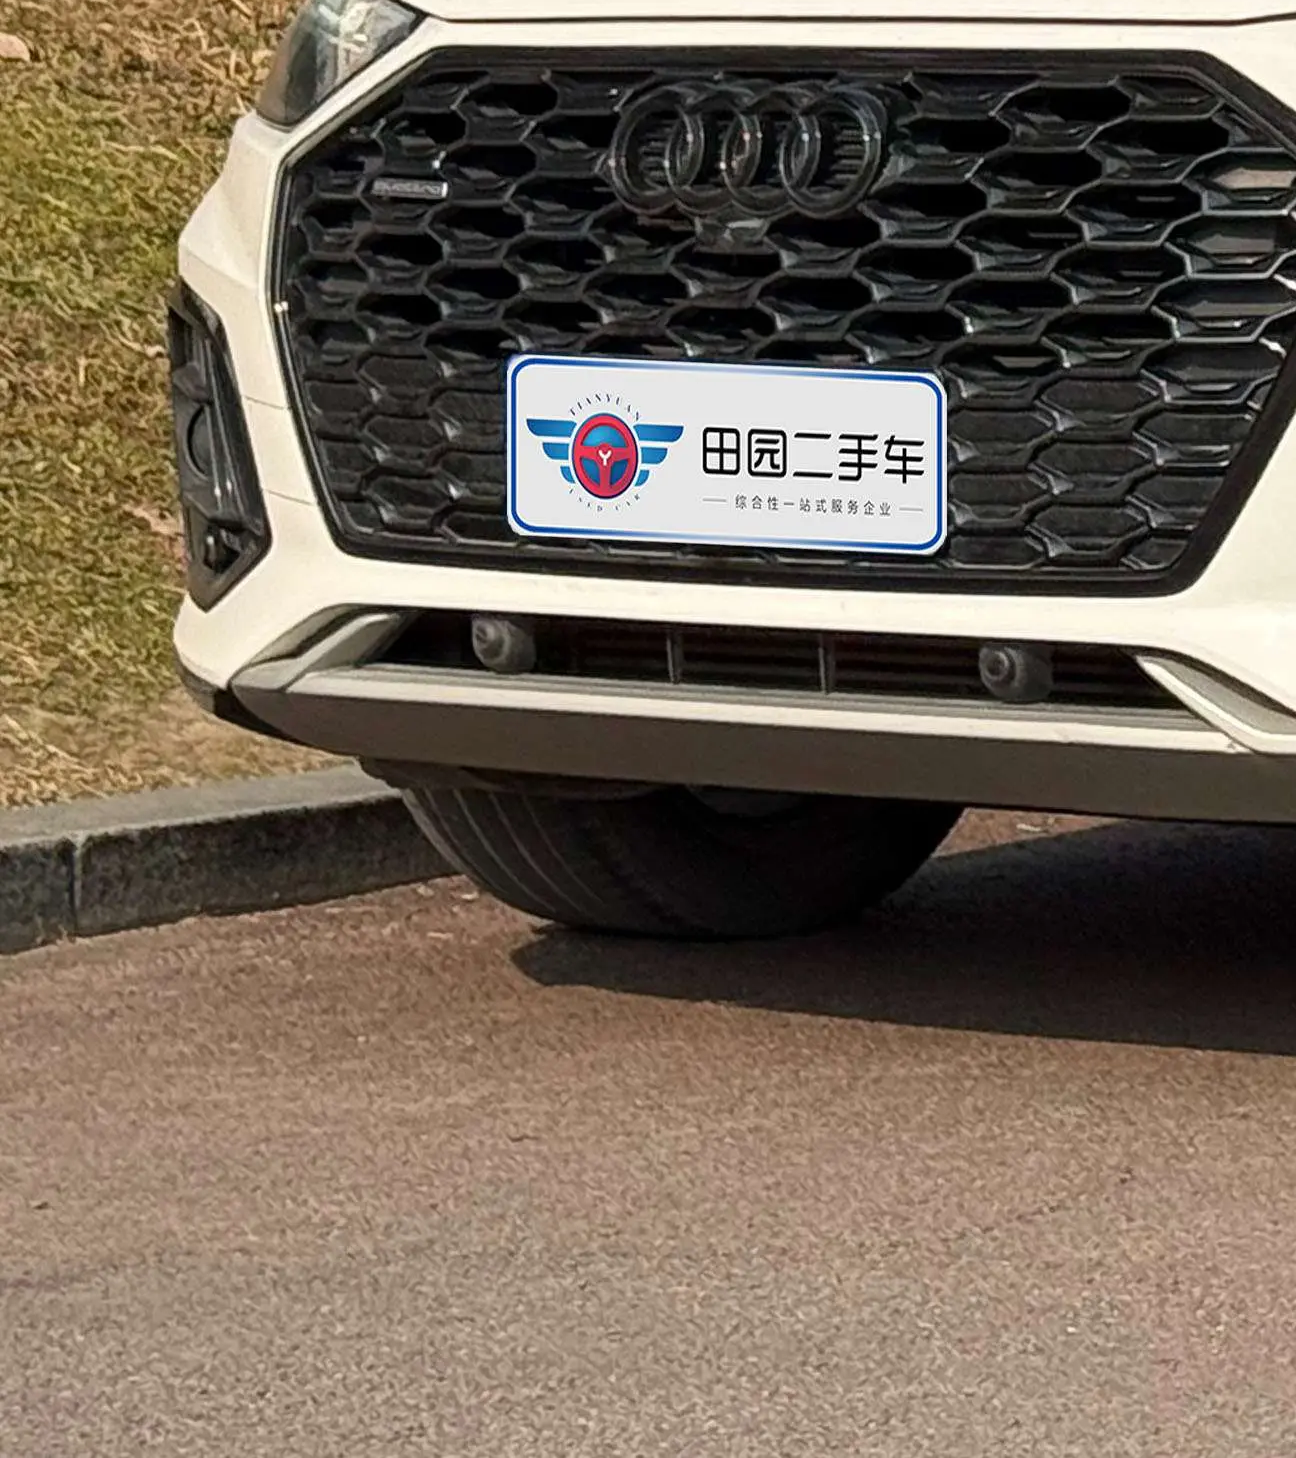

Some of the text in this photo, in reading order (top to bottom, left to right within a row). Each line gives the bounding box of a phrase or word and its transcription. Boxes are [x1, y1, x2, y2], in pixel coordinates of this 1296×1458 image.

[702, 426, 925, 485] 田园二手车
[735, 494, 891, 517] 综合性一站式服务企业
